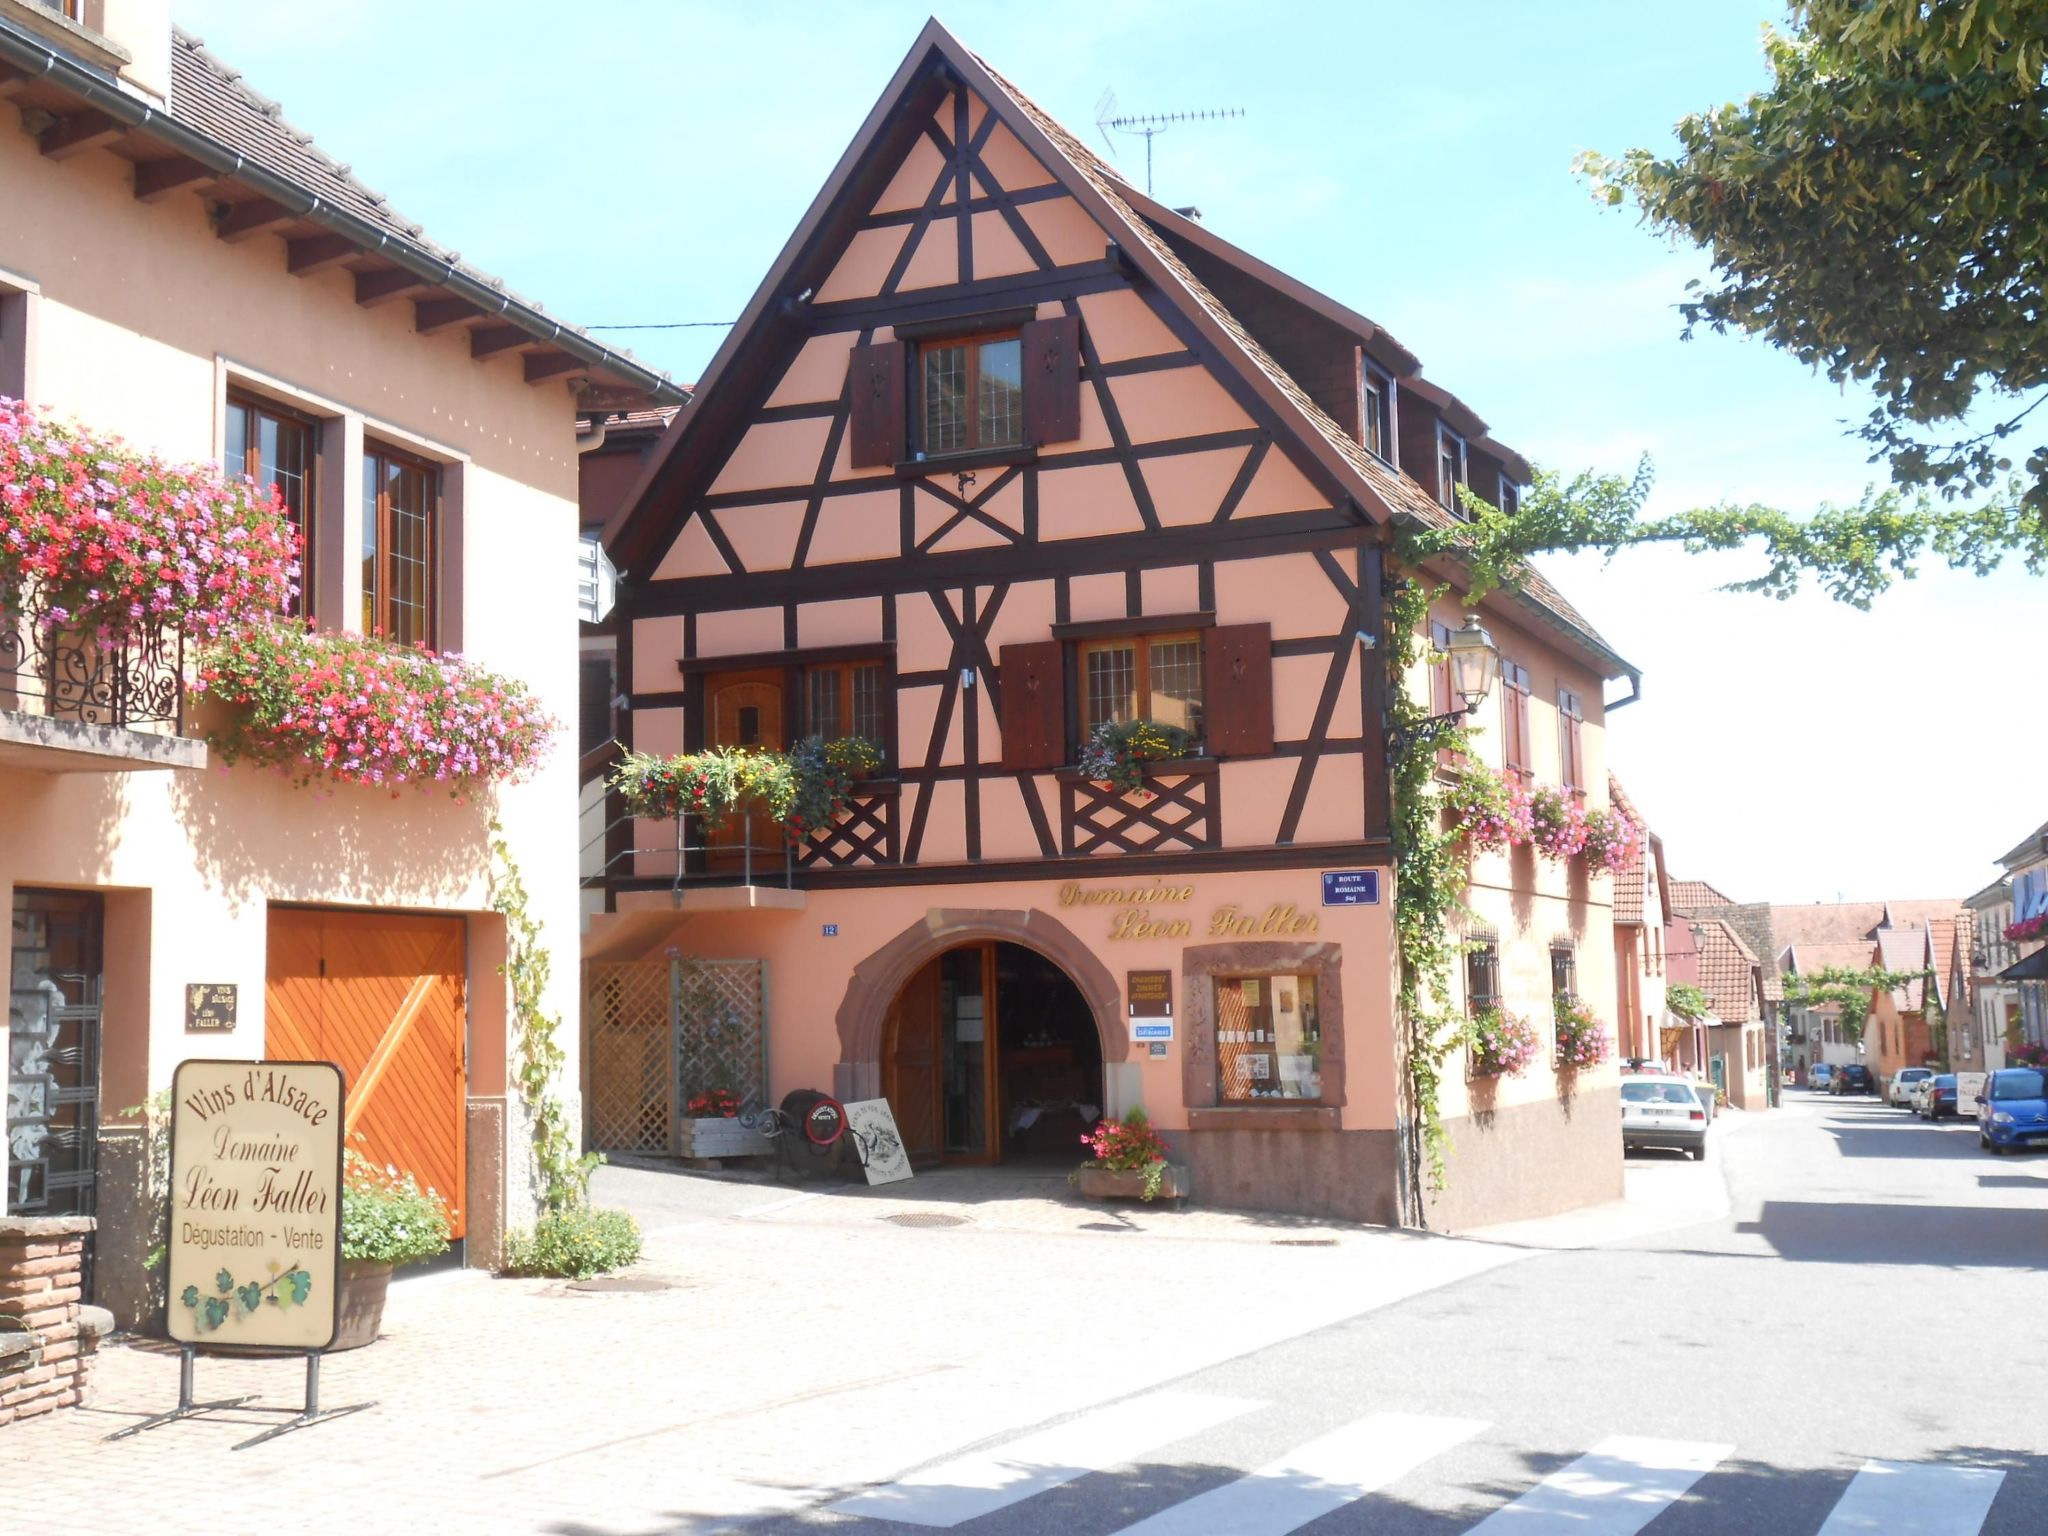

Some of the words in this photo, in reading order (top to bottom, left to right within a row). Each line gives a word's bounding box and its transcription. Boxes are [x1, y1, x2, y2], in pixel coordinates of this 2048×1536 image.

[1059, 879, 1193, 906] Domaine
[825, 927, 835, 935] 12
[1206, 904, 1319, 935] Faller
[185, 1083, 235, 1122] Vins
[243, 1070, 328, 1126] d'Alsace
[213, 1124, 299, 1162] Domaine
[183, 1165, 239, 1210] Léon
[253, 1167, 328, 1214] Faller
[183, 1222, 264, 1250] Dégustation
[284, 1226, 323, 1249] Vente
